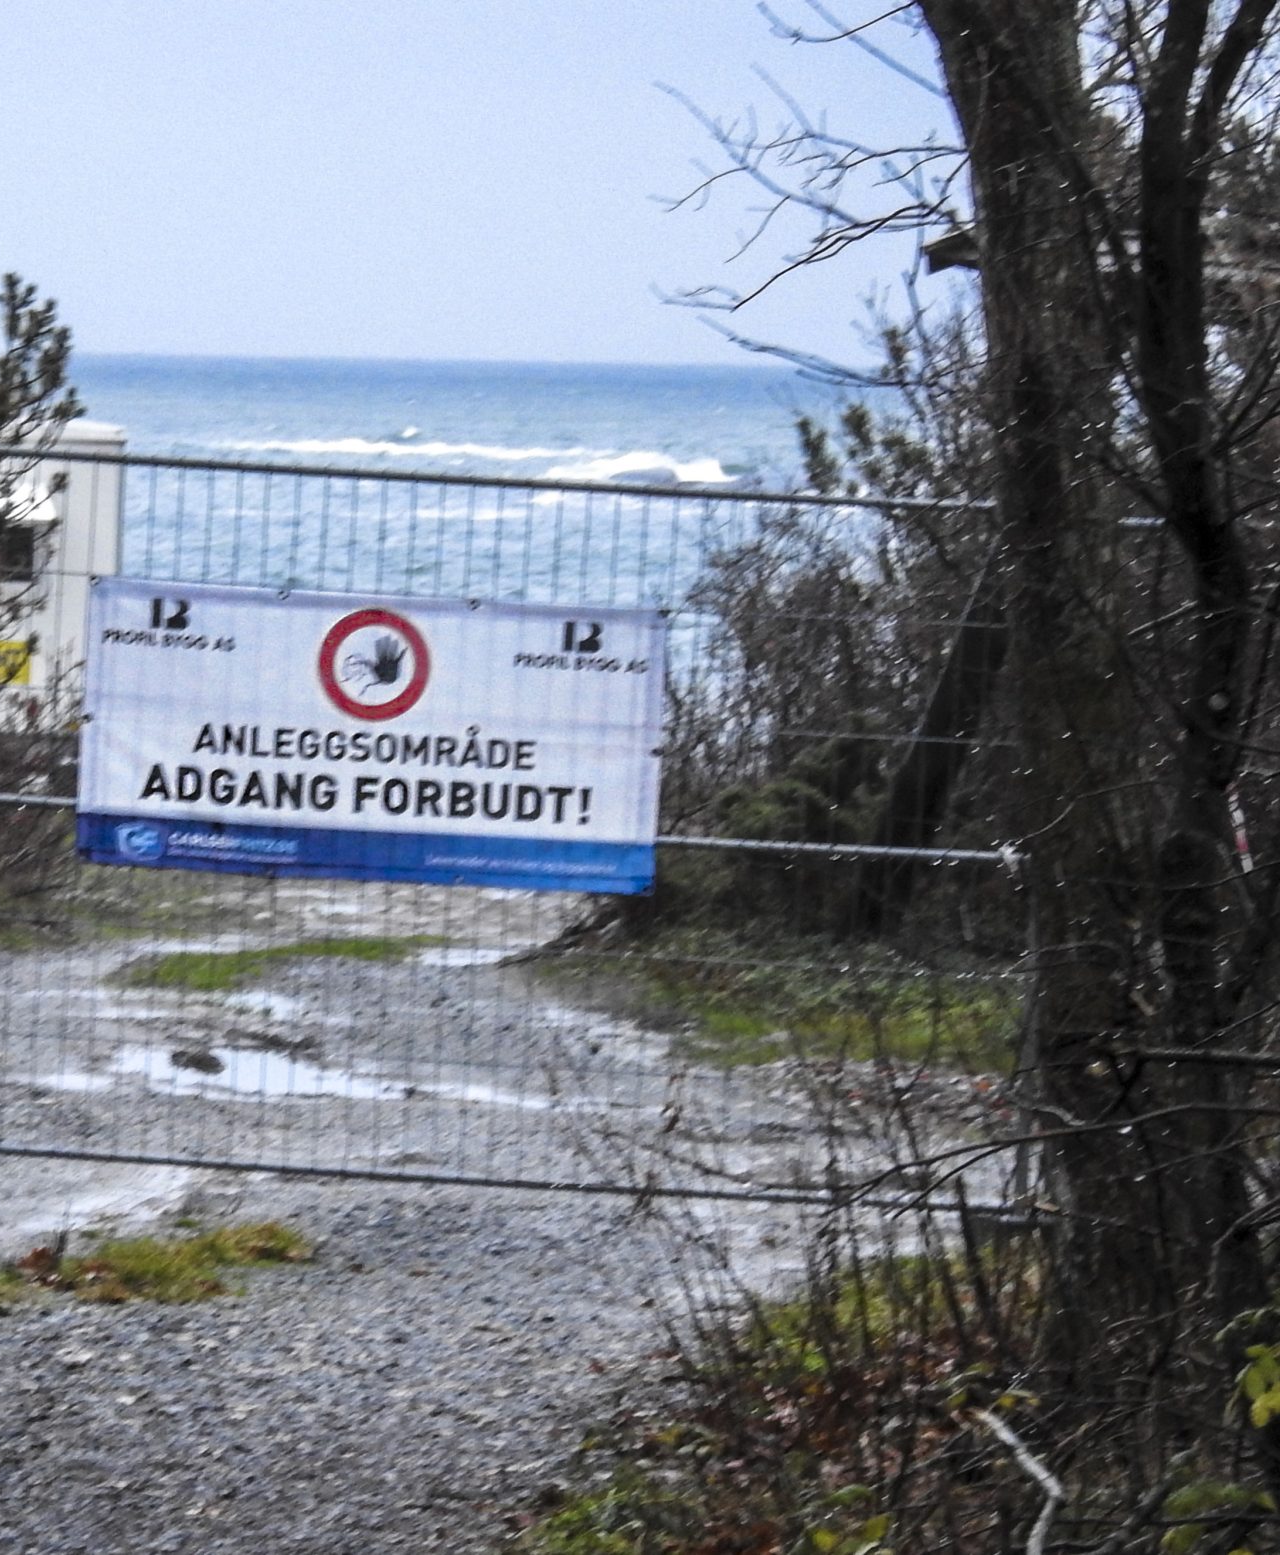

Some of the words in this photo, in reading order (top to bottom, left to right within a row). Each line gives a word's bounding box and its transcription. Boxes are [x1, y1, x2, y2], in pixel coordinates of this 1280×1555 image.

[101, 628, 157, 647] PROFIL
[161, 633, 209, 650] BYGG
[212, 636, 236, 652] AS
[513, 652, 570, 670] PROFIL
[573, 656, 621, 672] BYGG
[623, 657, 649, 674] AS
[193, 723, 537, 771] ANLEGGSOMRÅDE
[140, 763, 338, 811] ADGANG
[351, 776, 594, 825] FORBUDT!
